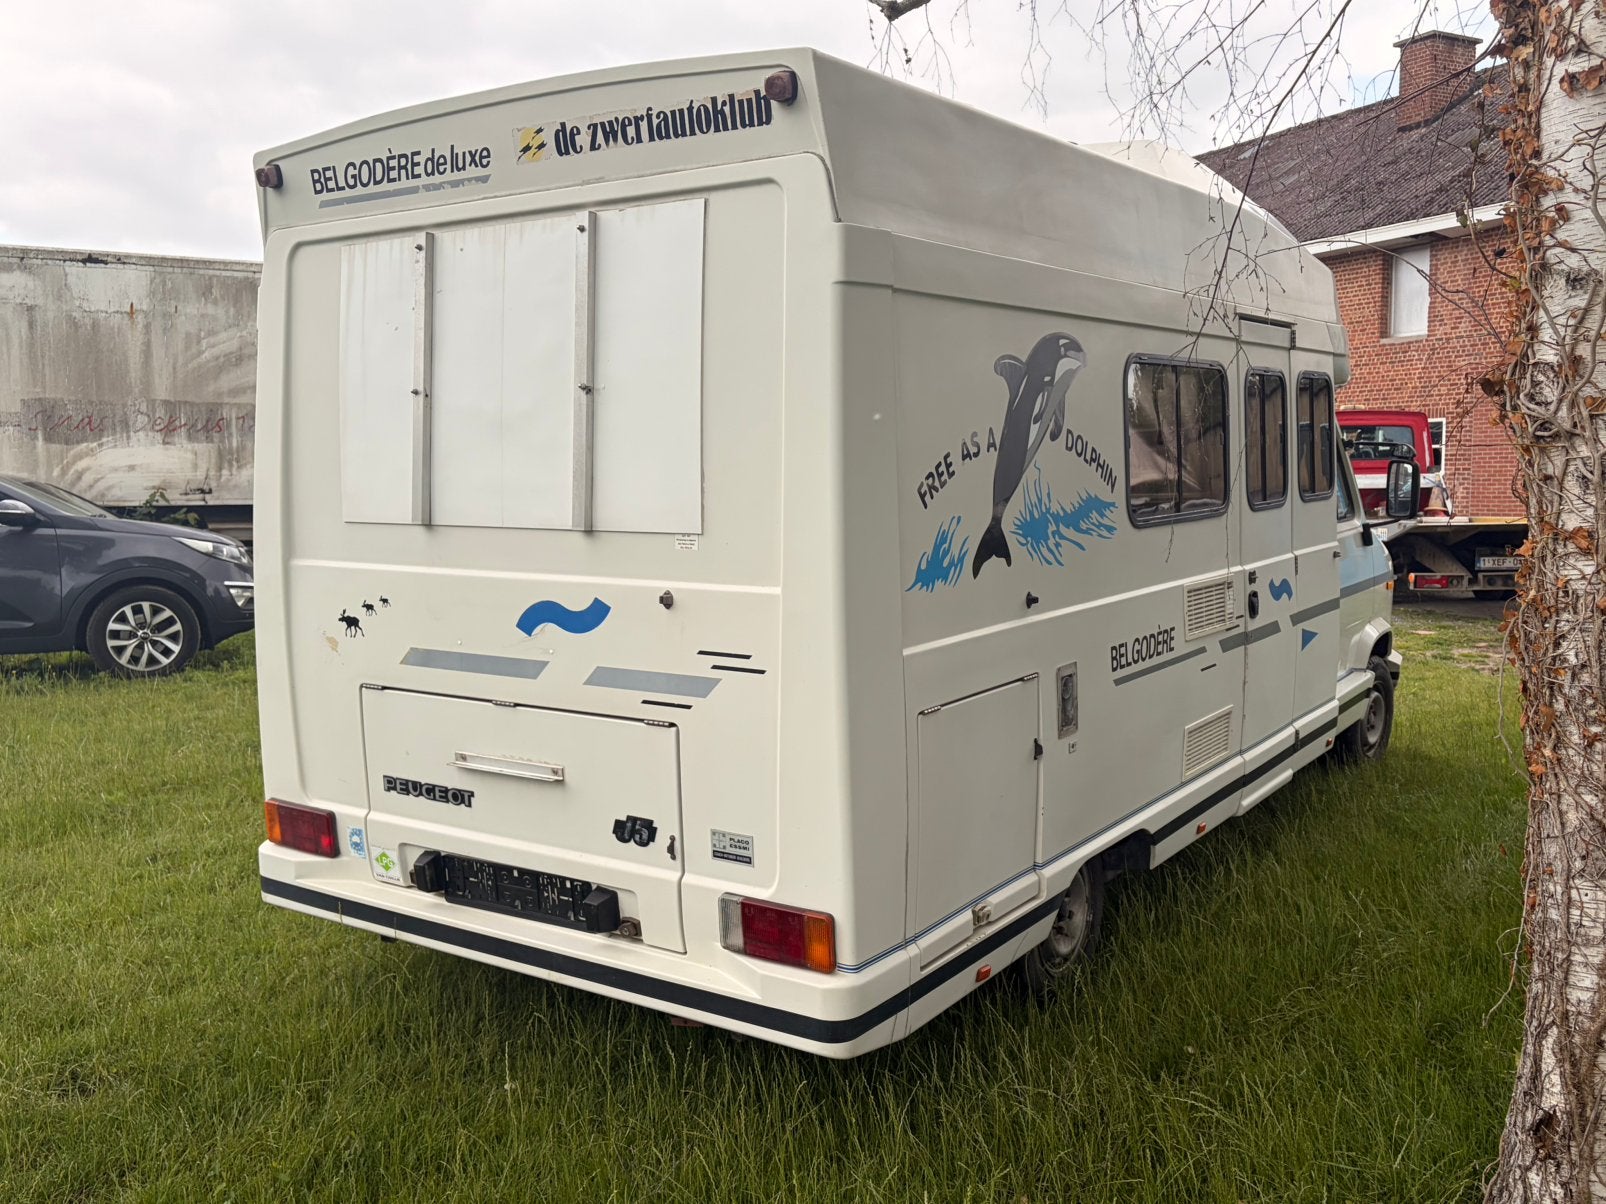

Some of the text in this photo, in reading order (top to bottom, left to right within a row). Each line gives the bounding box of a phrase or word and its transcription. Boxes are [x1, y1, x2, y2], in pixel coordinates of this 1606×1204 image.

[554, 89, 773, 157] de zwerfautoklub
[310, 148, 422, 195] BELGODÈRE
[916, 427, 1118, 509] FREE AS A DOLPHIN
[1110, 624, 1176, 672] BELGODÈRE
[383, 775, 475, 808] PEUGEOT
[612, 814, 658, 848] J5
[378, 856, 395, 868] LPG
